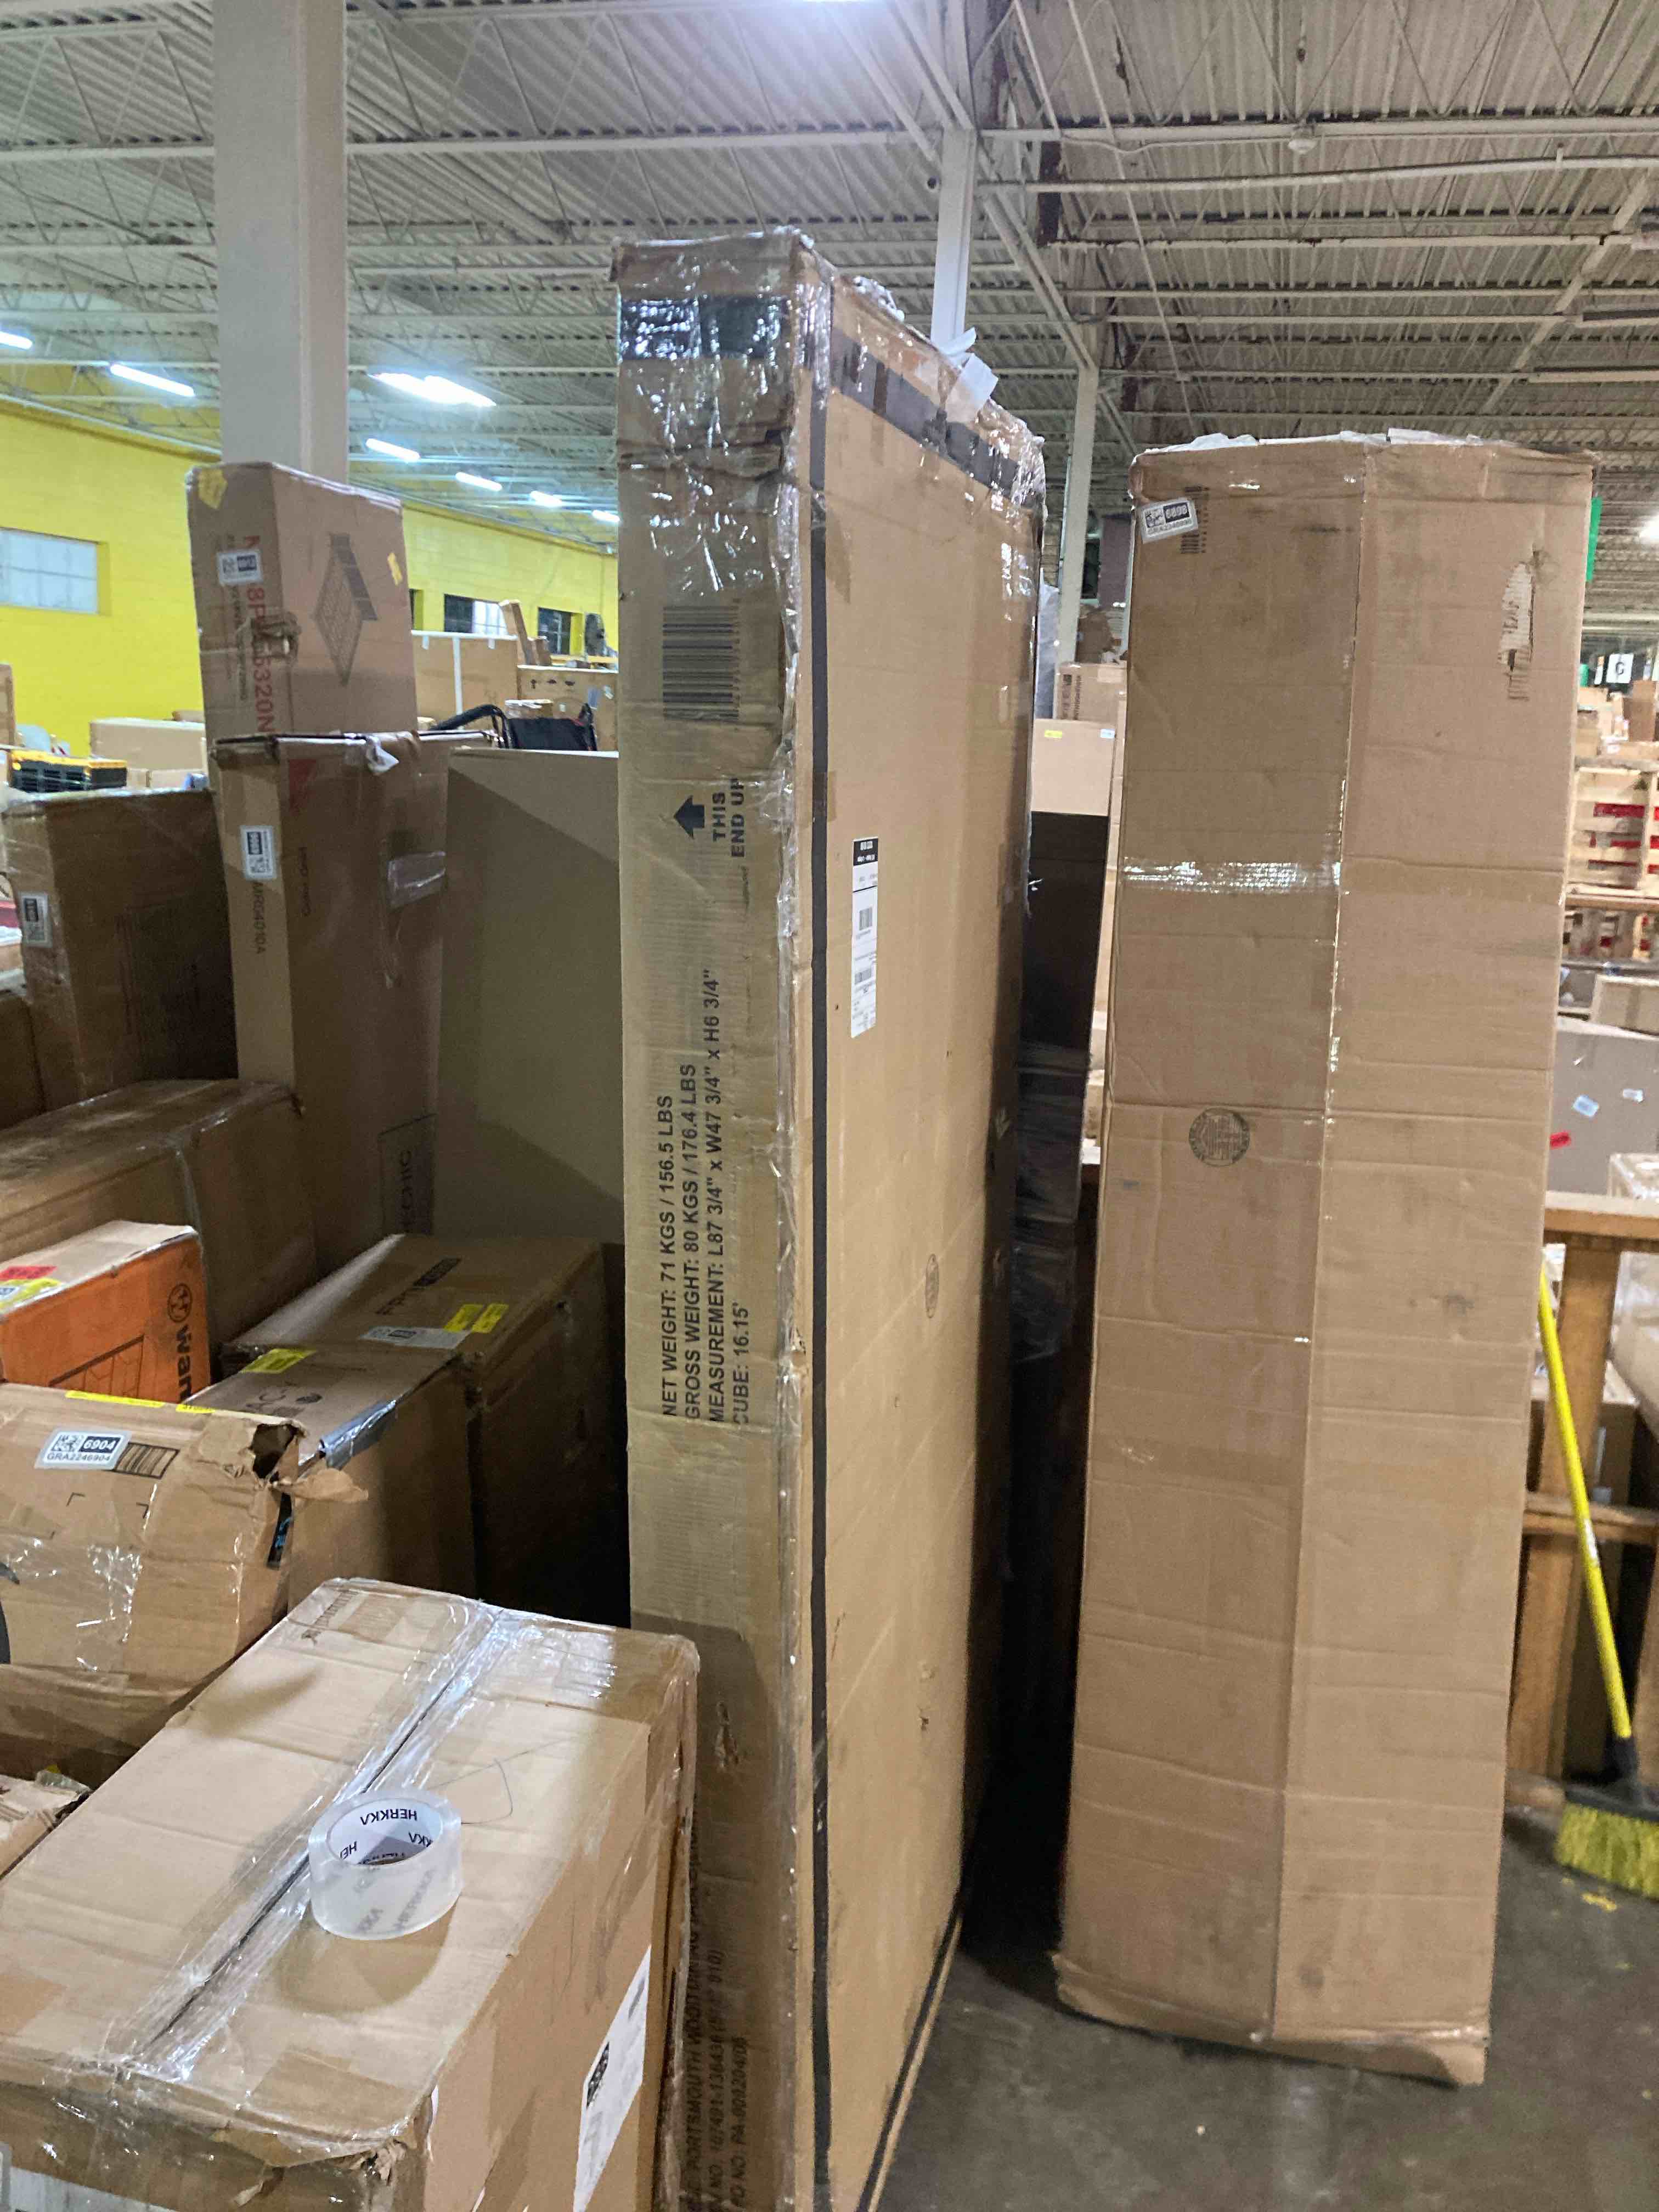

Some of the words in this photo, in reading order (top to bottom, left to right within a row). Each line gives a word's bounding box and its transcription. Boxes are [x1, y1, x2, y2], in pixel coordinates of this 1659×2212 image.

[730, 778, 744, 805] UP
[712, 792, 726, 842] THIS
[731, 815, 744, 857] END
[703, 969, 720, 1009] 3/4"
[703, 1017, 720, 1041] H6
[680, 1065, 696, 1104] LBS
[704, 1066, 721, 1104] 3/4"
[657, 1096, 673, 1136] LBS
[706, 1114, 722, 1153] W47
[681, 1111, 697, 1167] 176.4
[658, 1143, 674, 1192] 156.5
[682, 1181, 698, 1223] KGS
[706, 1177, 723, 1215] 3/4"
[659, 1212, 675, 1255] KGS
[684, 1231, 698, 1252] 80
[707, 1222, 723, 1255] L87
[661, 1262, 675, 1282] 71
[684, 1260, 700, 1342] WEIGHT:
[661, 1290, 677, 1371] WEIGHT:
[707, 1263, 725, 1422] MEASUREMENT:
[662, 1379, 678, 1416] NET
[685, 1350, 701, 1420] GROSS
[47, 1452, 111, 1462] GRA2246904
[83, 1438, 114, 1451] 6904
